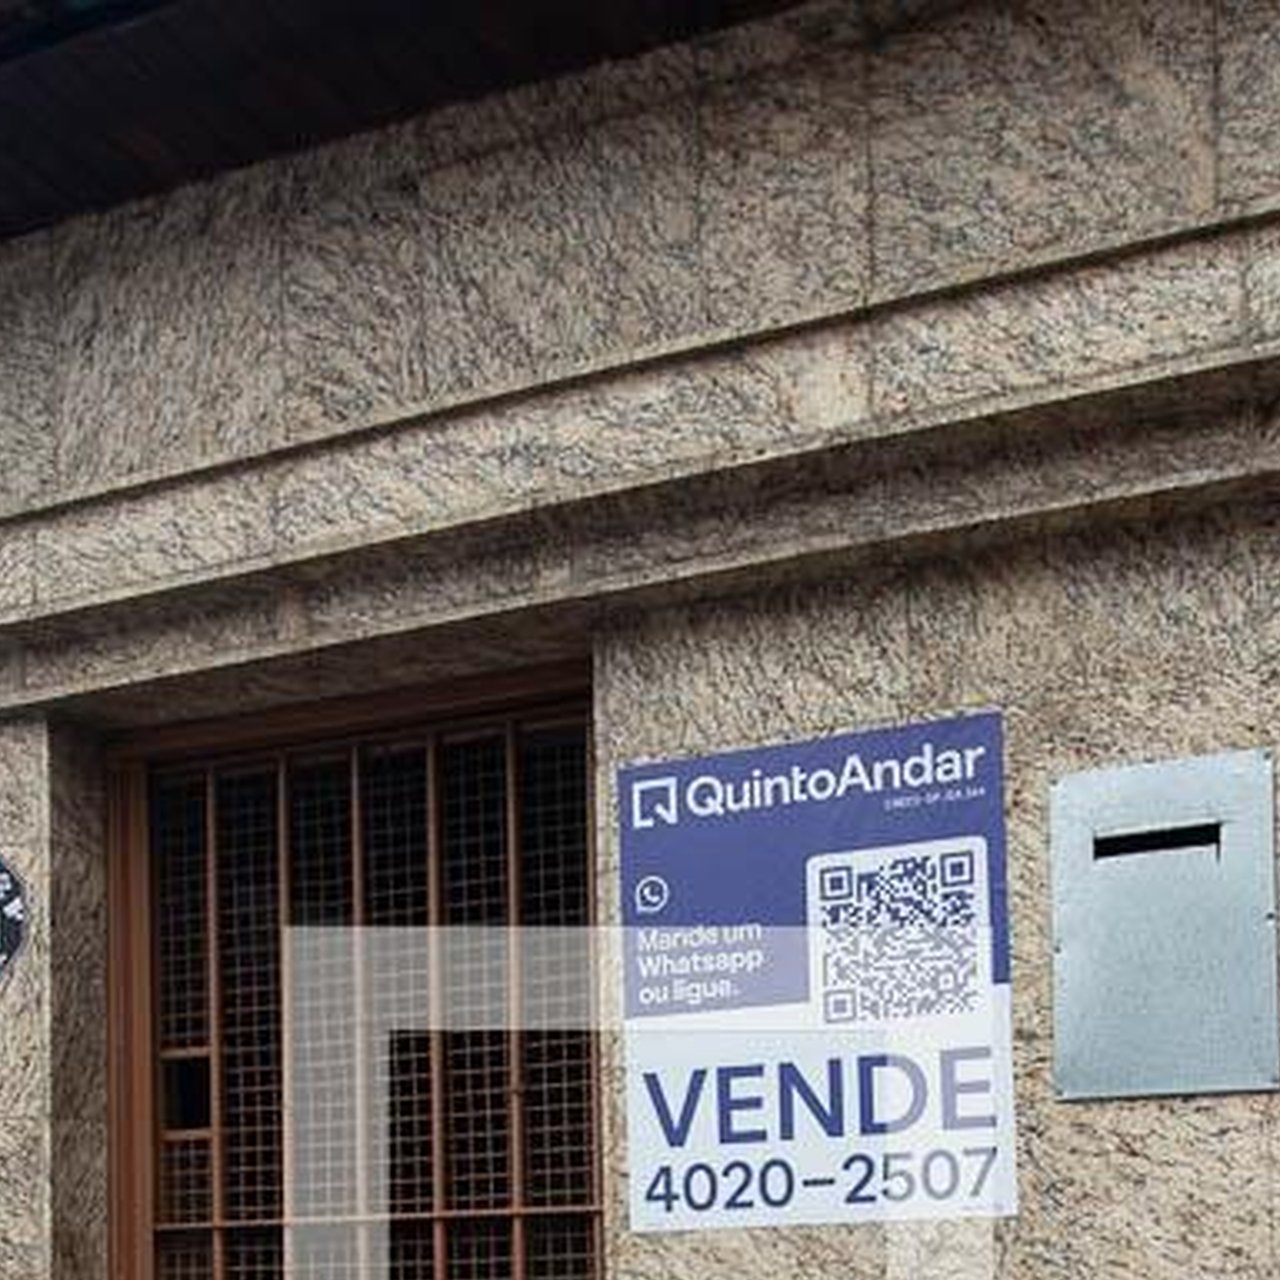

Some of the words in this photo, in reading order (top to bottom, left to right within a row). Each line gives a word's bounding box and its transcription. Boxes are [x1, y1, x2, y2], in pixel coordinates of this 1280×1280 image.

[686, 743, 986, 818] QuintoAndar
[637, 926, 719, 952] Mande
[722, 923, 762, 945] um
[637, 949, 764, 978] Whatsapp
[638, 984, 669, 1004] ou
[643, 1046, 998, 1149] VENDE
[644, 1146, 999, 1213] 4020-2507
